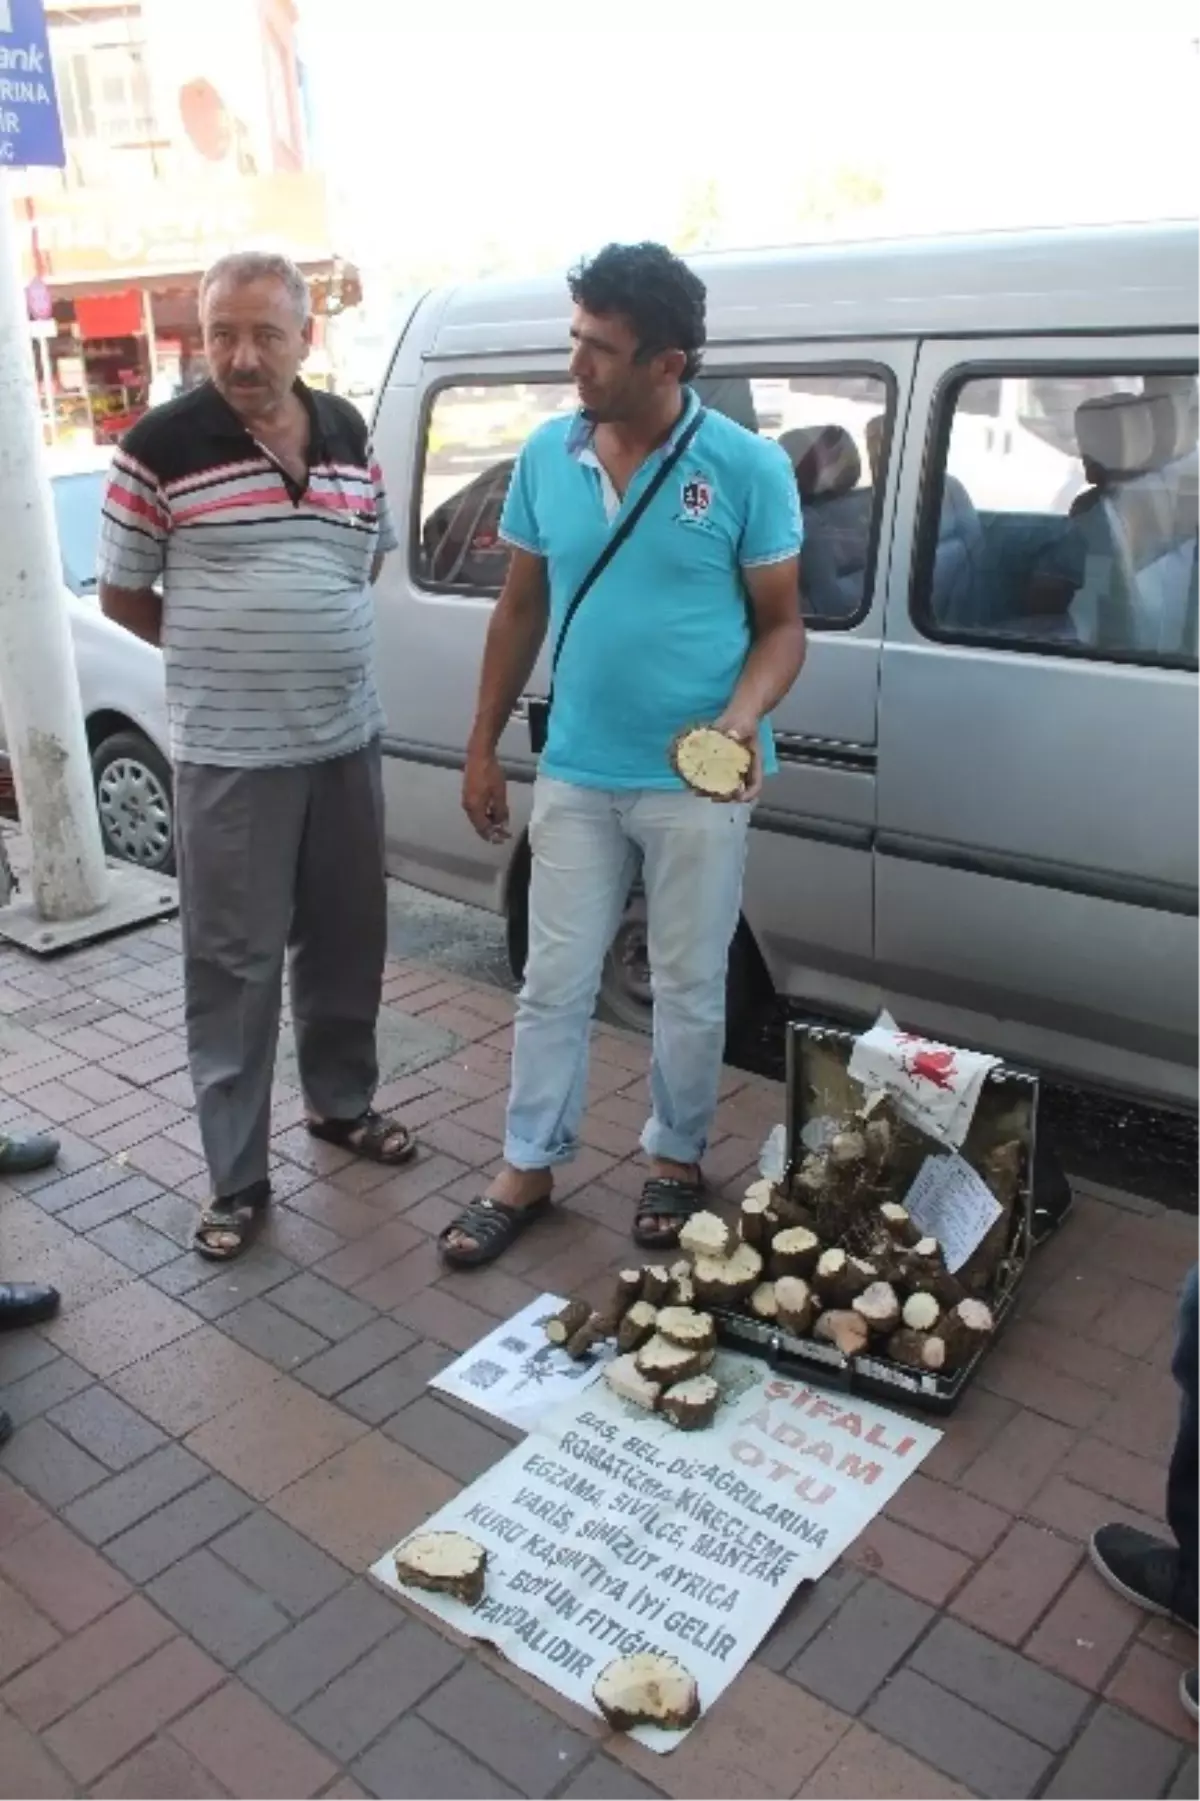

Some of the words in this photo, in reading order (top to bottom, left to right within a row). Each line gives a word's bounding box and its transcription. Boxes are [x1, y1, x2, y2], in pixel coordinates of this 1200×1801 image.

[730, 1439, 837, 1505] OTU
[738, 1407, 883, 1485] ADAM
[655, 1564, 740, 1612] AYRICA
[689, 1533, 788, 1588] MANTAR
[663, 1610, 738, 1662] GELİR
